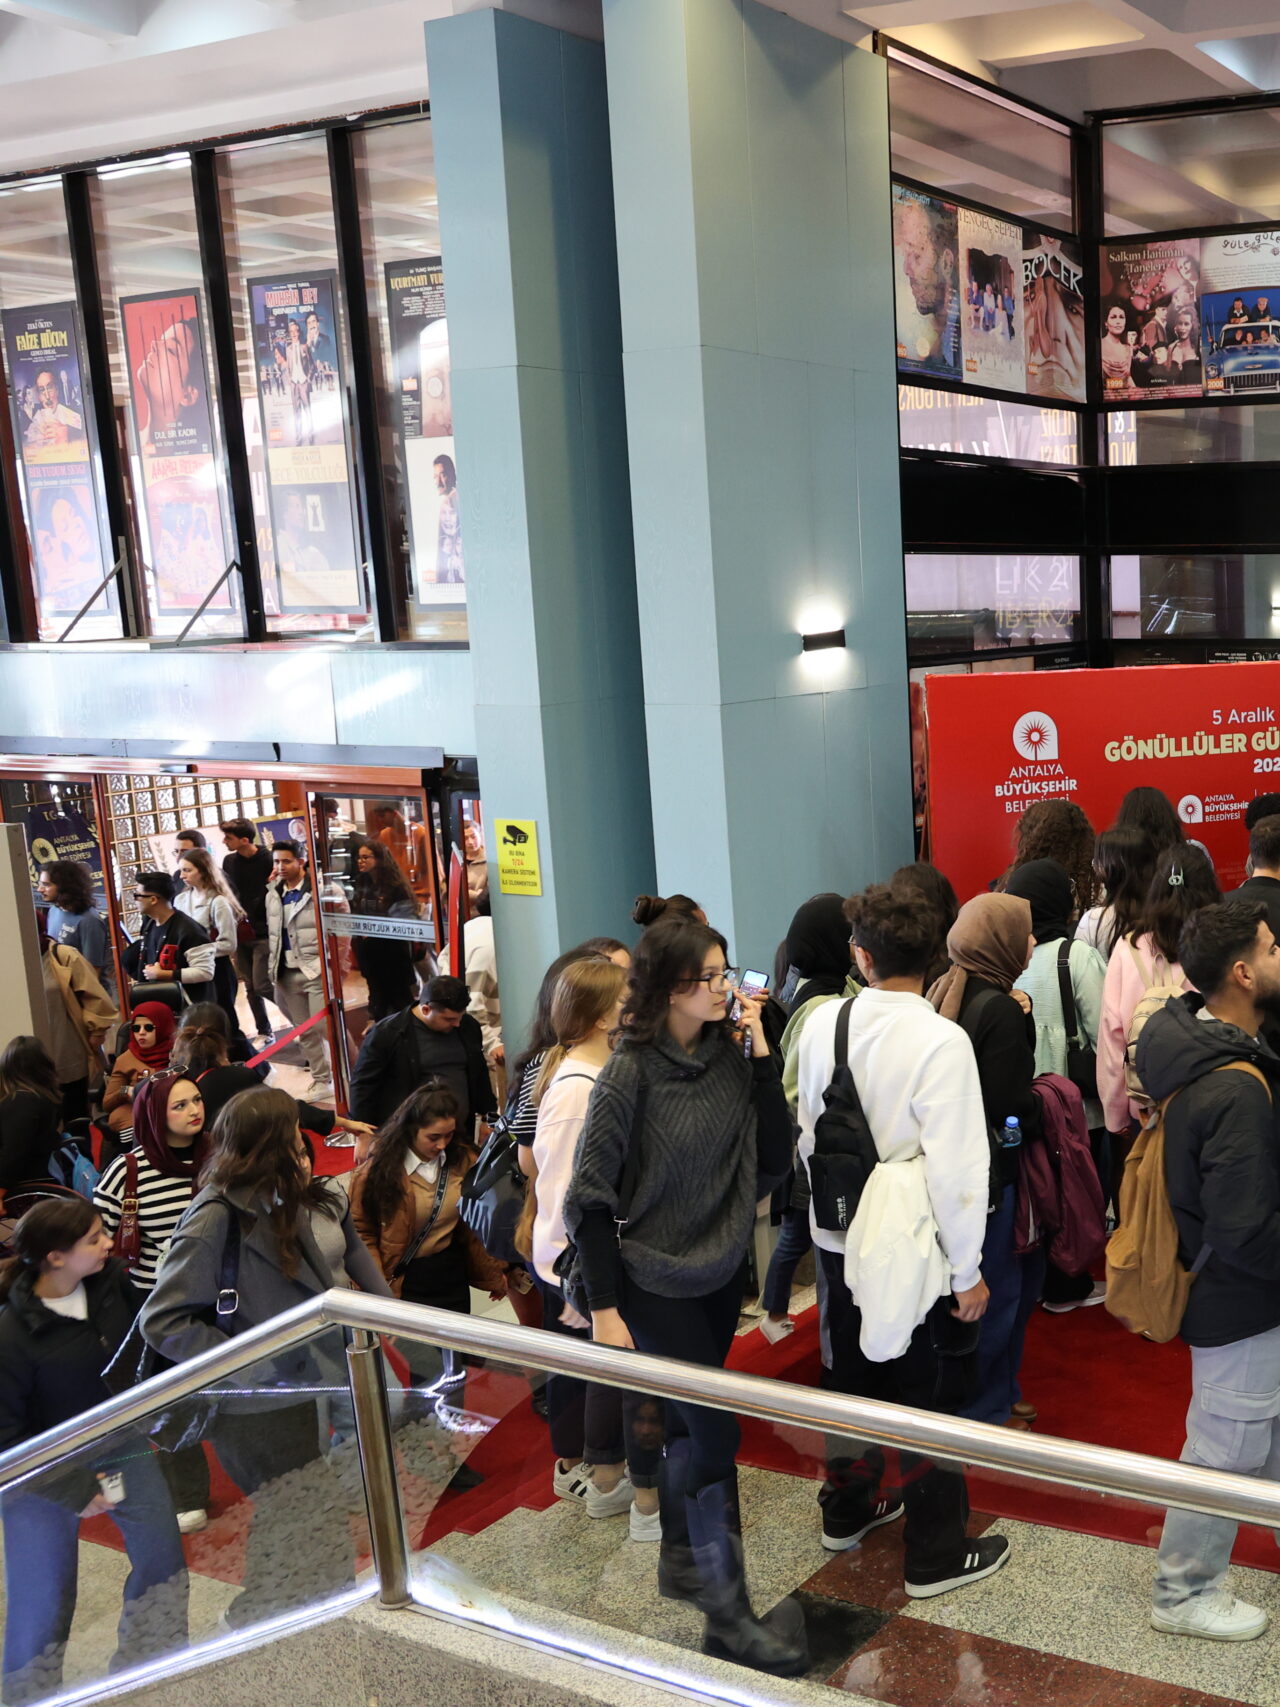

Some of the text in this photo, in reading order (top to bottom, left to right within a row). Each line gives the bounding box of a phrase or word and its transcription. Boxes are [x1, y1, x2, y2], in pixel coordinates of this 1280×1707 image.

[1109, 249, 1141, 263] Salkım
[16, 329, 68, 352] FAİZE HÜCUM
[1106, 379, 1124, 388] 1999
[1207, 380, 1224, 389] 2000
[1211, 710, 1222, 725] 5
[1227, 706, 1275, 725] Aralık
[1103, 729, 1248, 762] GÖNÜLLÜLER
[1008, 763, 1065, 779] ANTALYA
[994, 778, 1078, 798] BÜYÜKŞEHİR
[1204, 793, 1235, 803] ANTALYA
[1205, 811, 1241, 822] BELEDİYESİ
